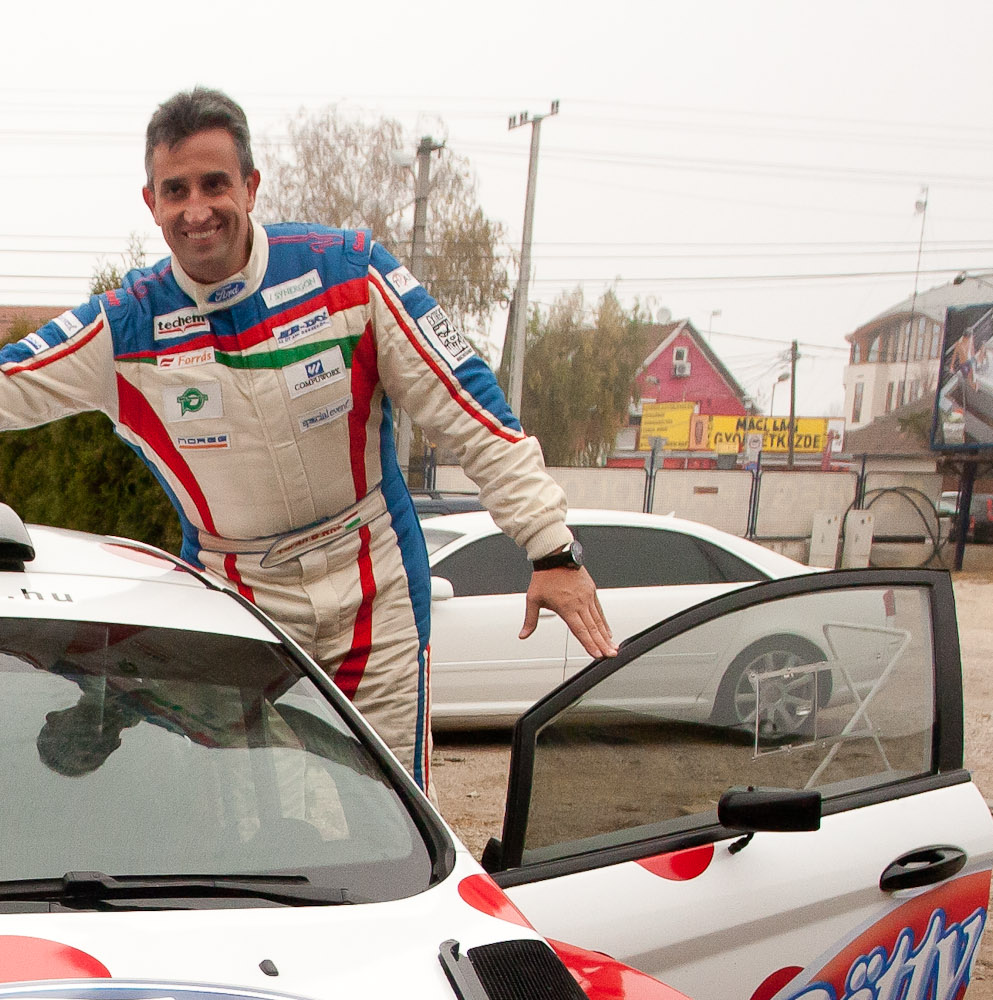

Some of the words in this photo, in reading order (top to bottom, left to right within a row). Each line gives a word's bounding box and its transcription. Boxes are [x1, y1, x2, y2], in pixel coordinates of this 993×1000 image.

[214, 284, 240, 302] Ford
[157, 314, 205, 331] techem
[772, 417, 799, 433] LAI
